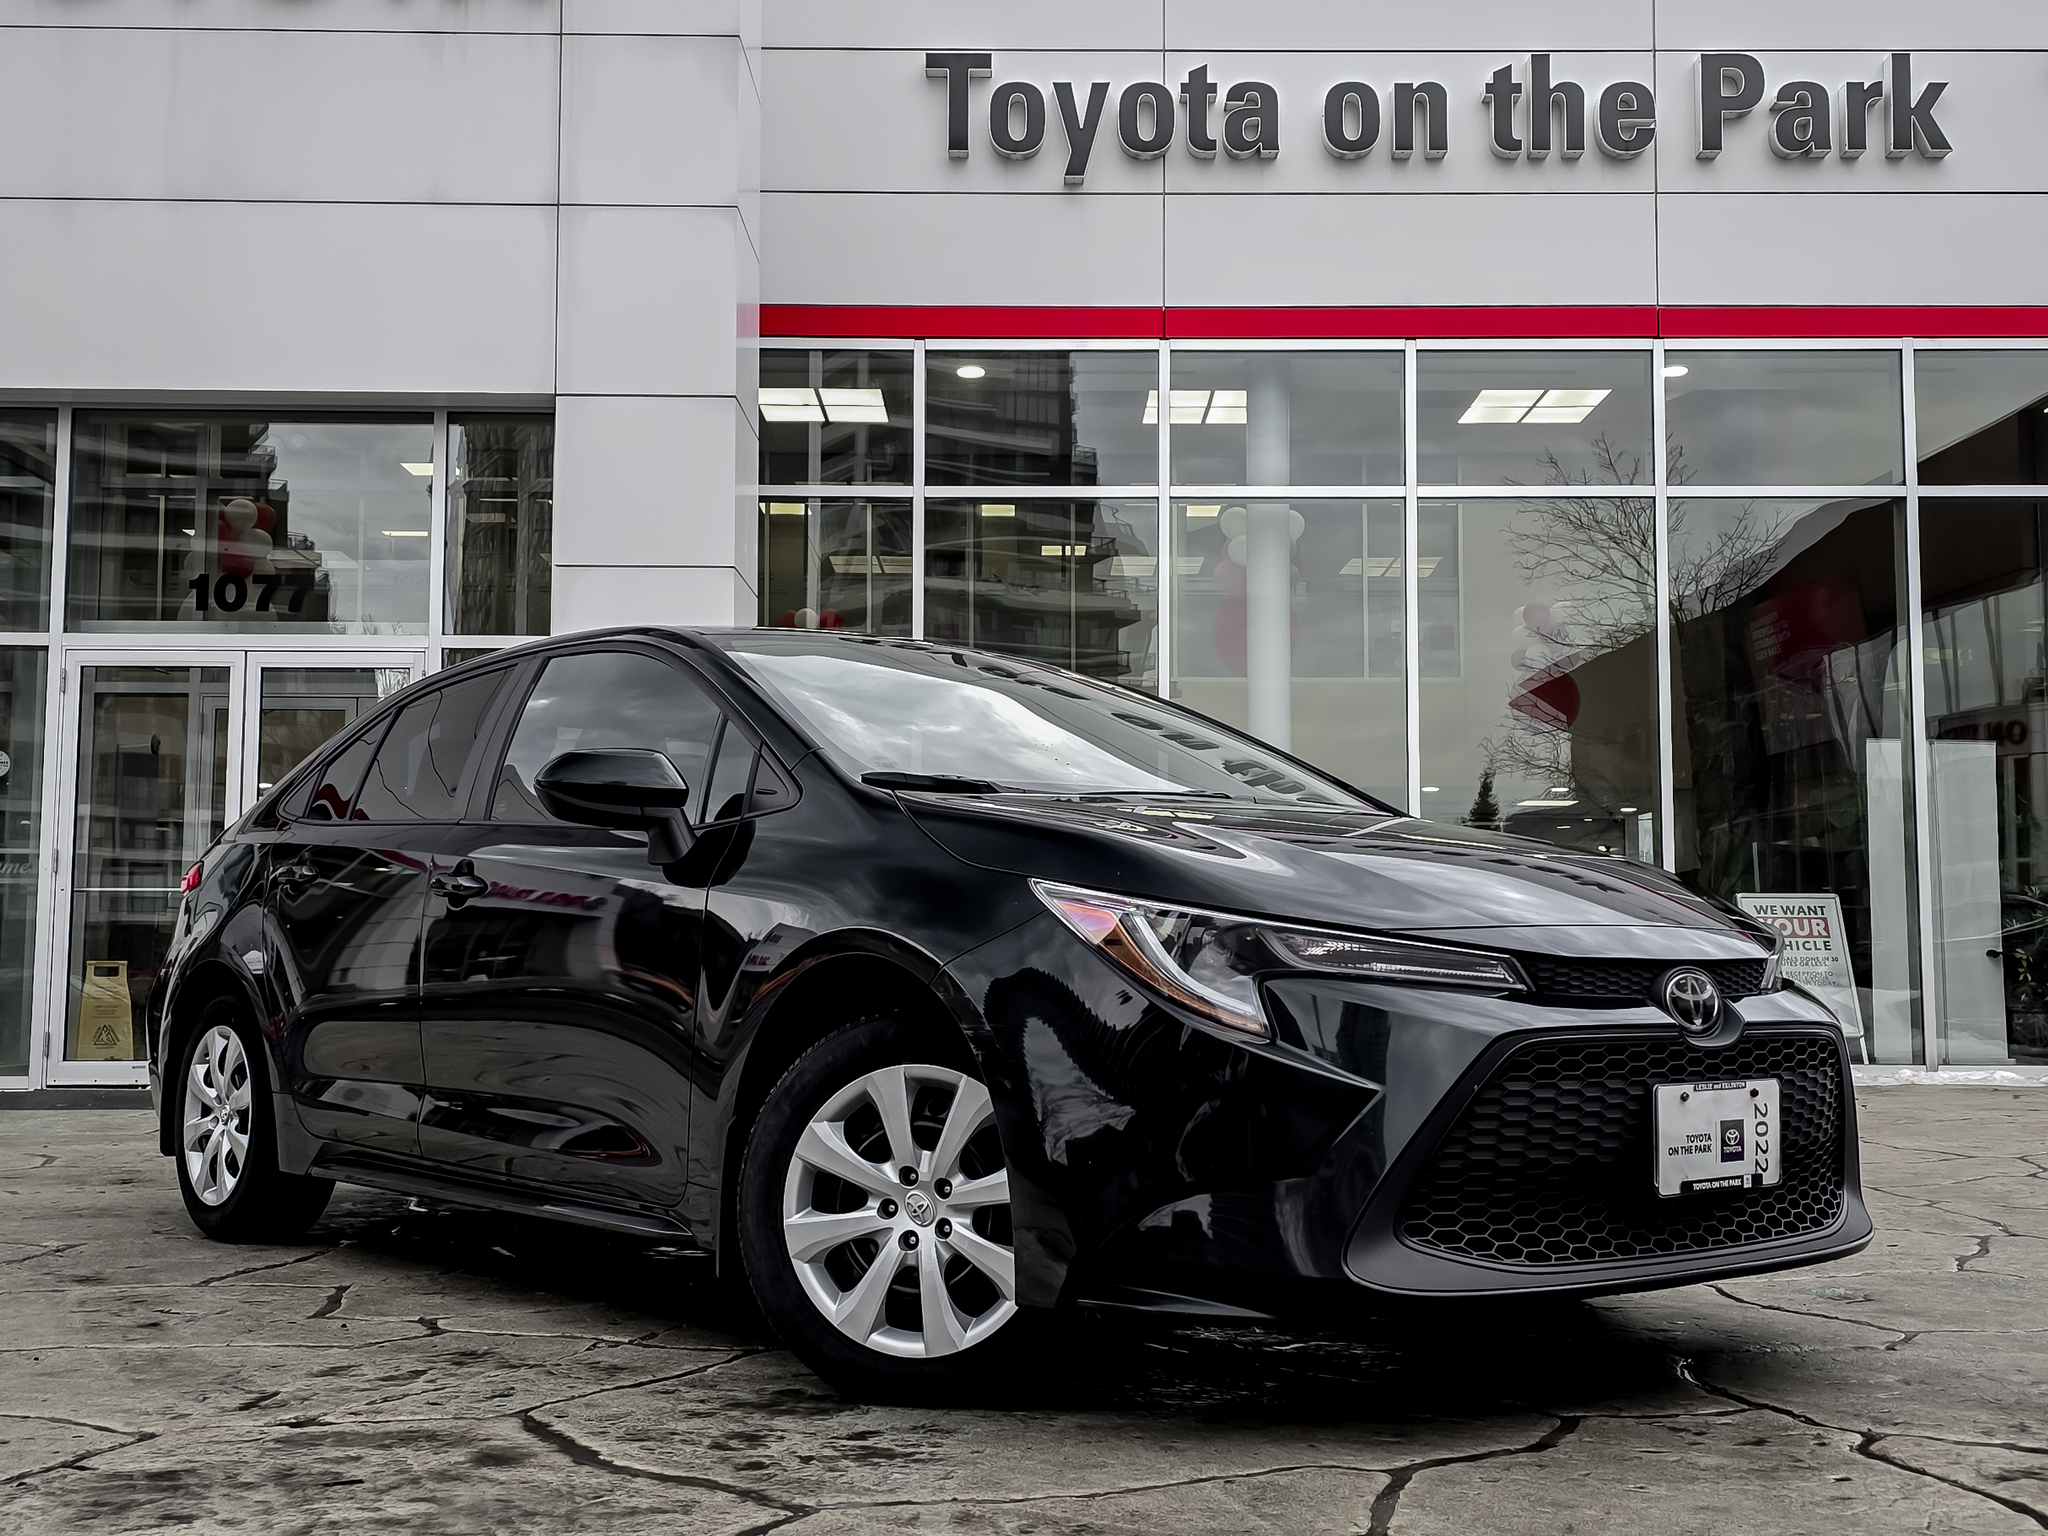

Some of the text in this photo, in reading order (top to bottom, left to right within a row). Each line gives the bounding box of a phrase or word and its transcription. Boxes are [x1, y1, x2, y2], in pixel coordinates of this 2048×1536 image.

[925, 52, 1953, 184] Toyota on the Park
[189, 573, 315, 612] 1077
[1753, 905, 1826, 916] WE WANT
[1784, 940, 1832, 951] HICLE
[1686, 1133, 1712, 1144] TOYOTA
[1753, 1102, 1769, 1174] 2022
[1668, 1143, 1712, 1156] ON THE PARK
[1693, 1182, 1712, 1190] TOYOTA
[1720, 1179, 1729, 1187] THE
[1729, 1178, 1742, 1186] PARK
